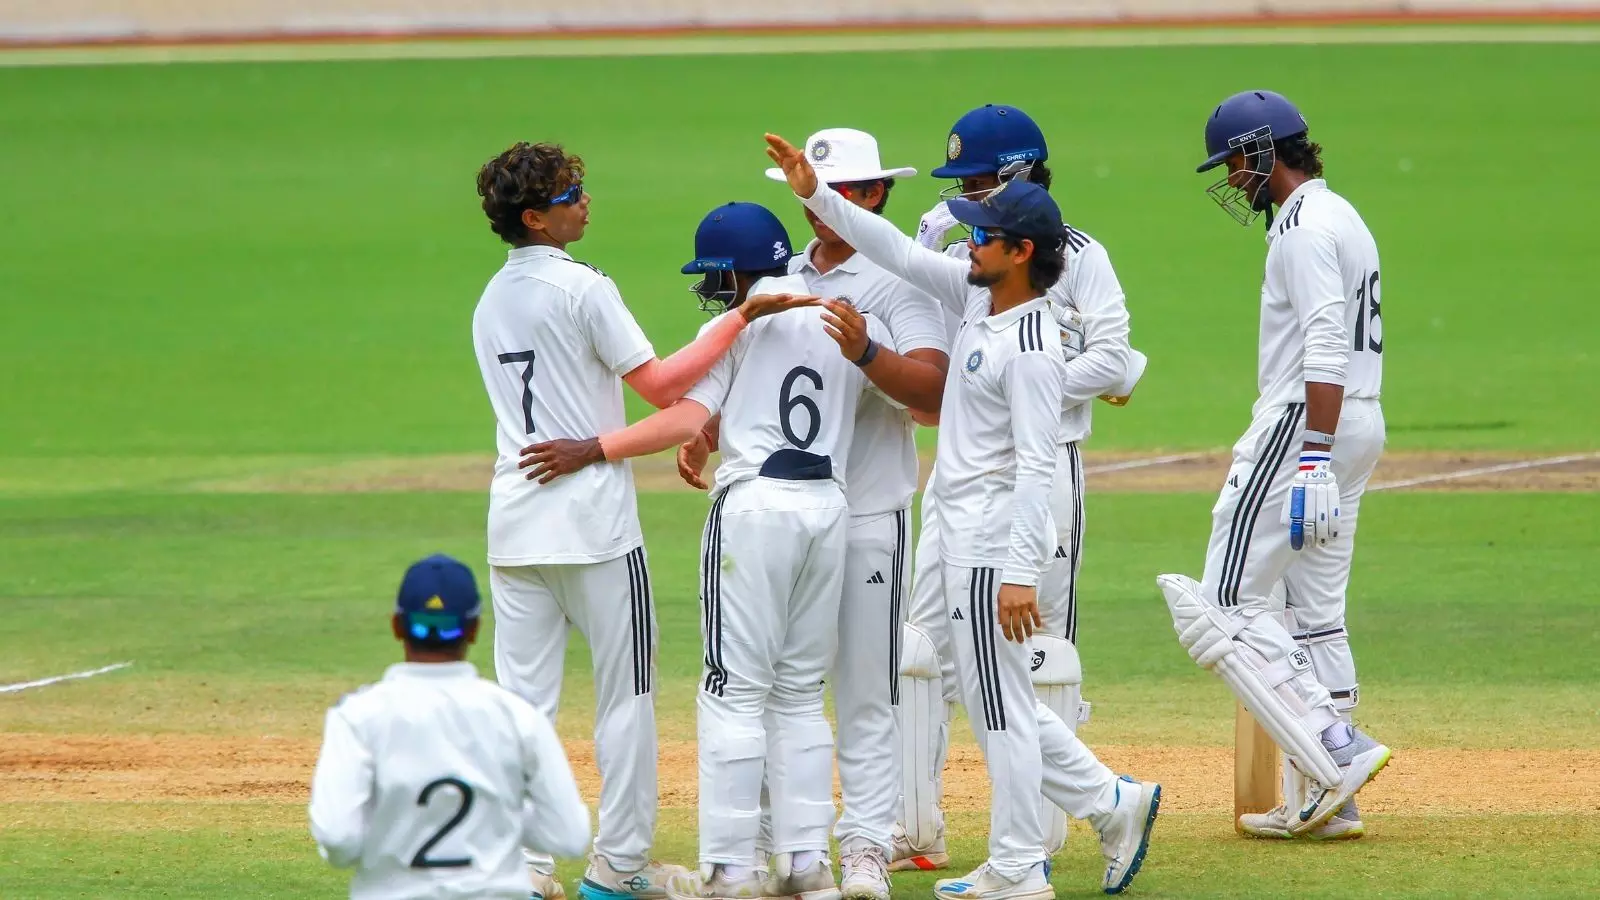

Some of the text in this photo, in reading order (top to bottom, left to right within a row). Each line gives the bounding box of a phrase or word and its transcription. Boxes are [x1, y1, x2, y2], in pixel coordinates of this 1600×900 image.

[1006, 153, 1026, 162] SHREY
[1354, 269, 1383, 355] 18
[498, 350, 536, 433] 7
[778, 366, 823, 449] 6
[1294, 651, 1308, 666] SS
[410, 777, 475, 869] 2
